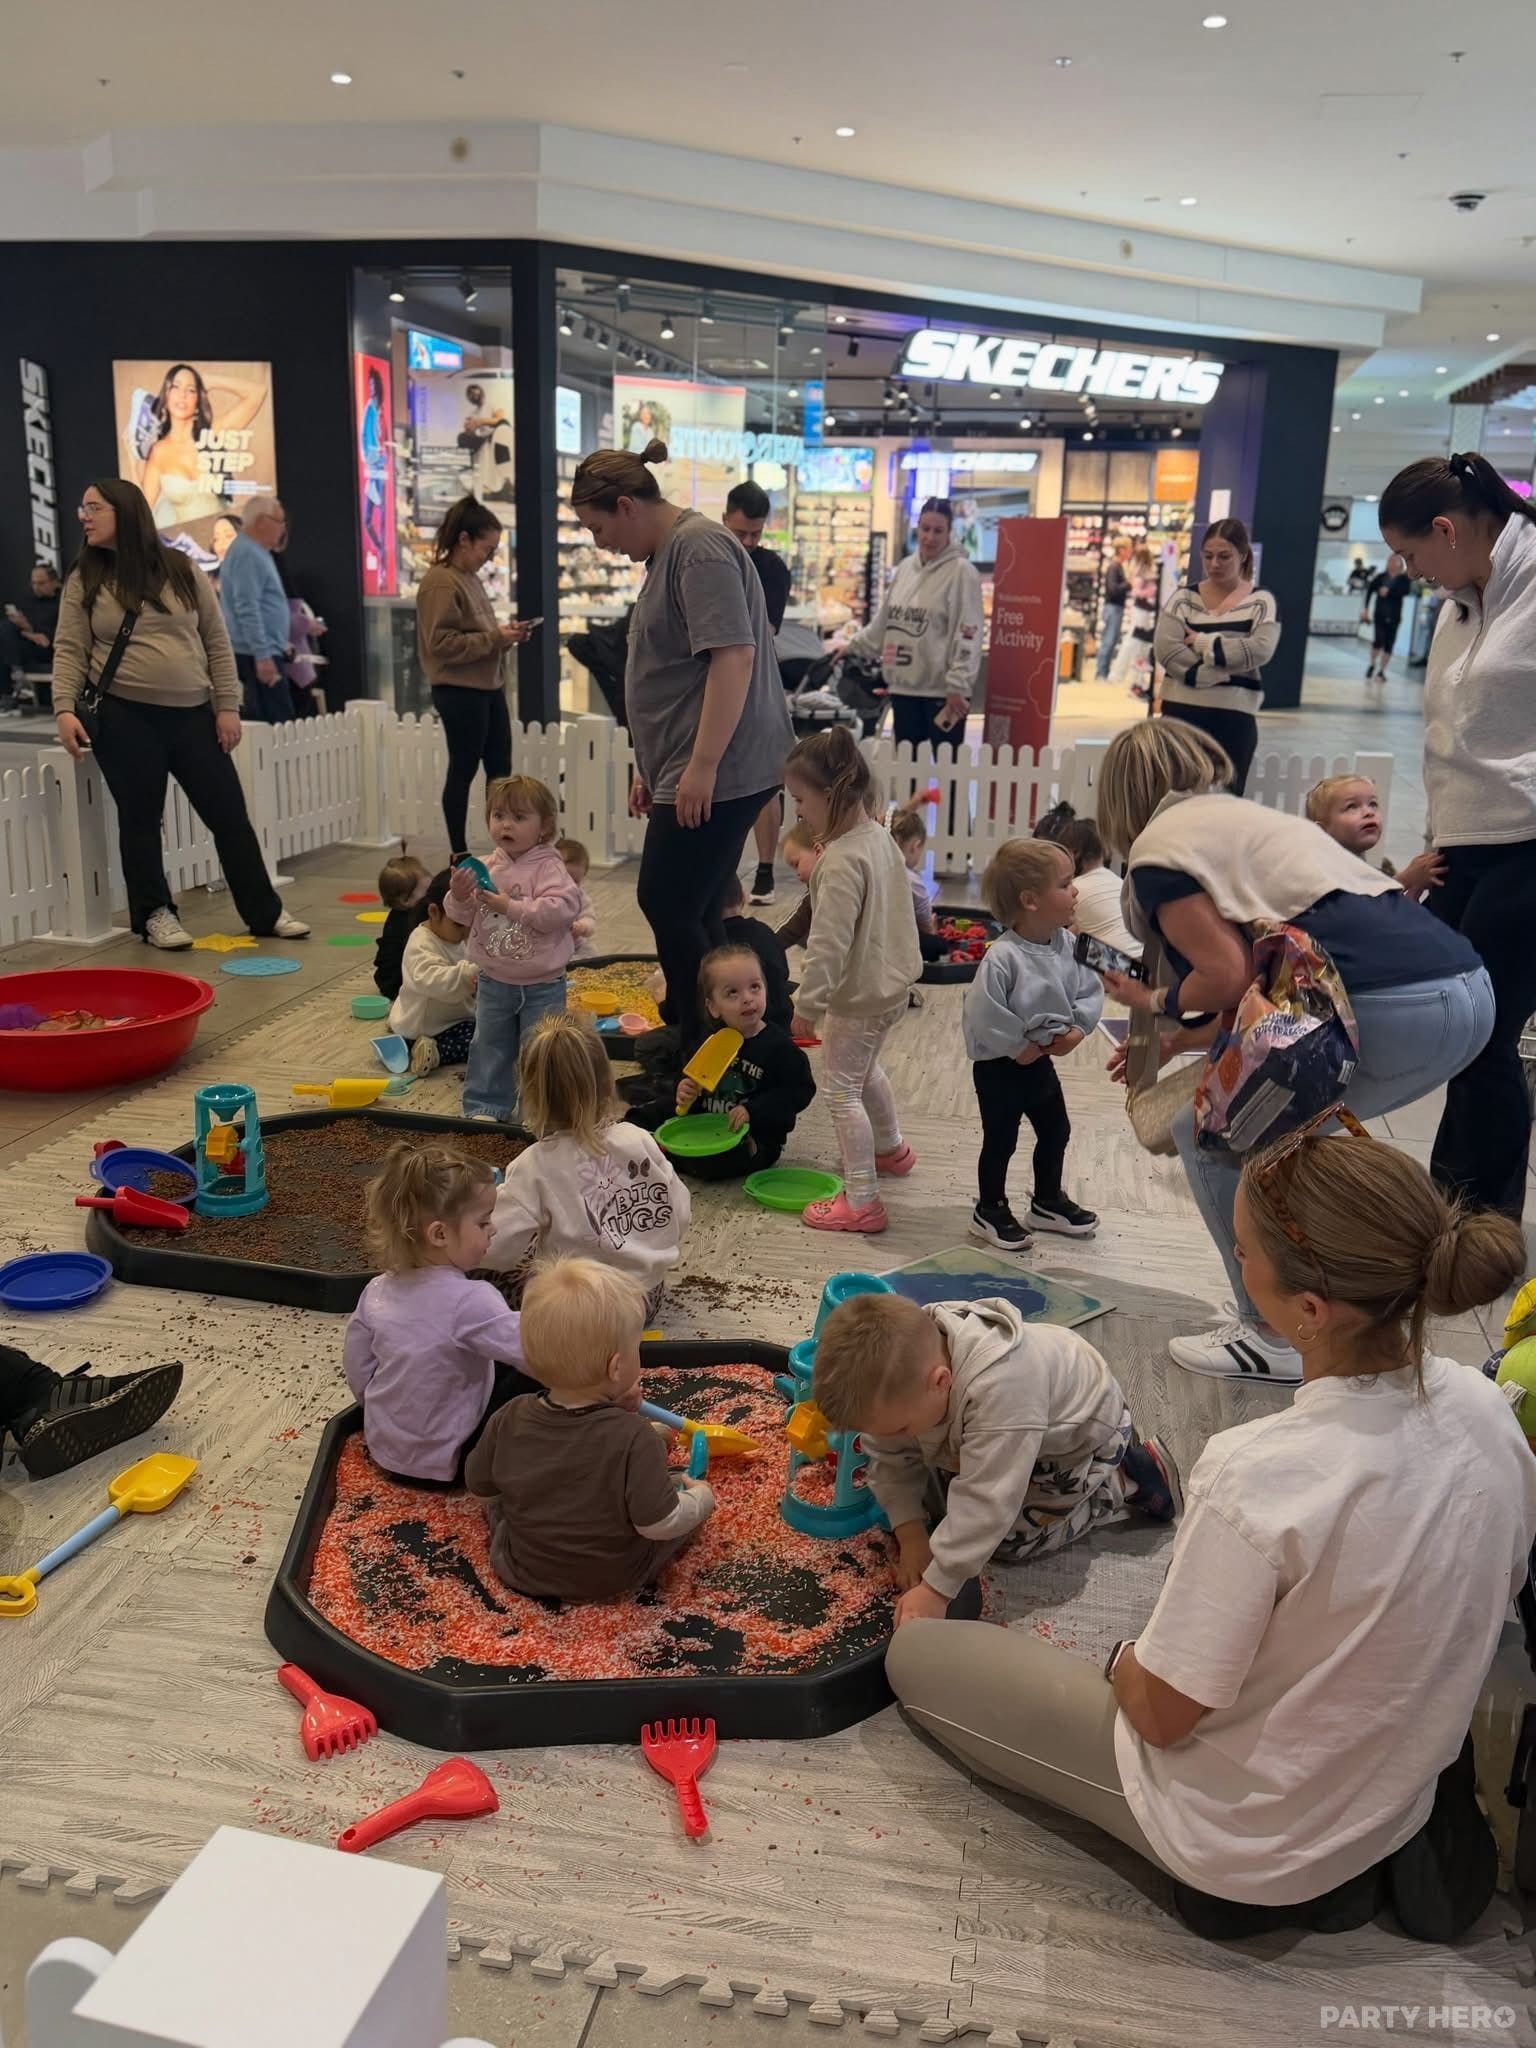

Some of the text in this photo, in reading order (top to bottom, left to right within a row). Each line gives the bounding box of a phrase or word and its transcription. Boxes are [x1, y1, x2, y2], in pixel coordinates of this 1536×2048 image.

[902, 328, 1224, 405] SKECHERS
[194, 428, 254, 450] JUST
[20, 358, 63, 578] SKECHER
[196, 451, 255, 473] STEP
[199, 473, 224, 495] IN
[996, 607, 1024, 626] Free
[994, 628, 1045, 654] Activity
[741, 1059, 764, 1080] THE
[614, 1181, 669, 1216] BIG
[600, 1205, 674, 1250] HUGS
